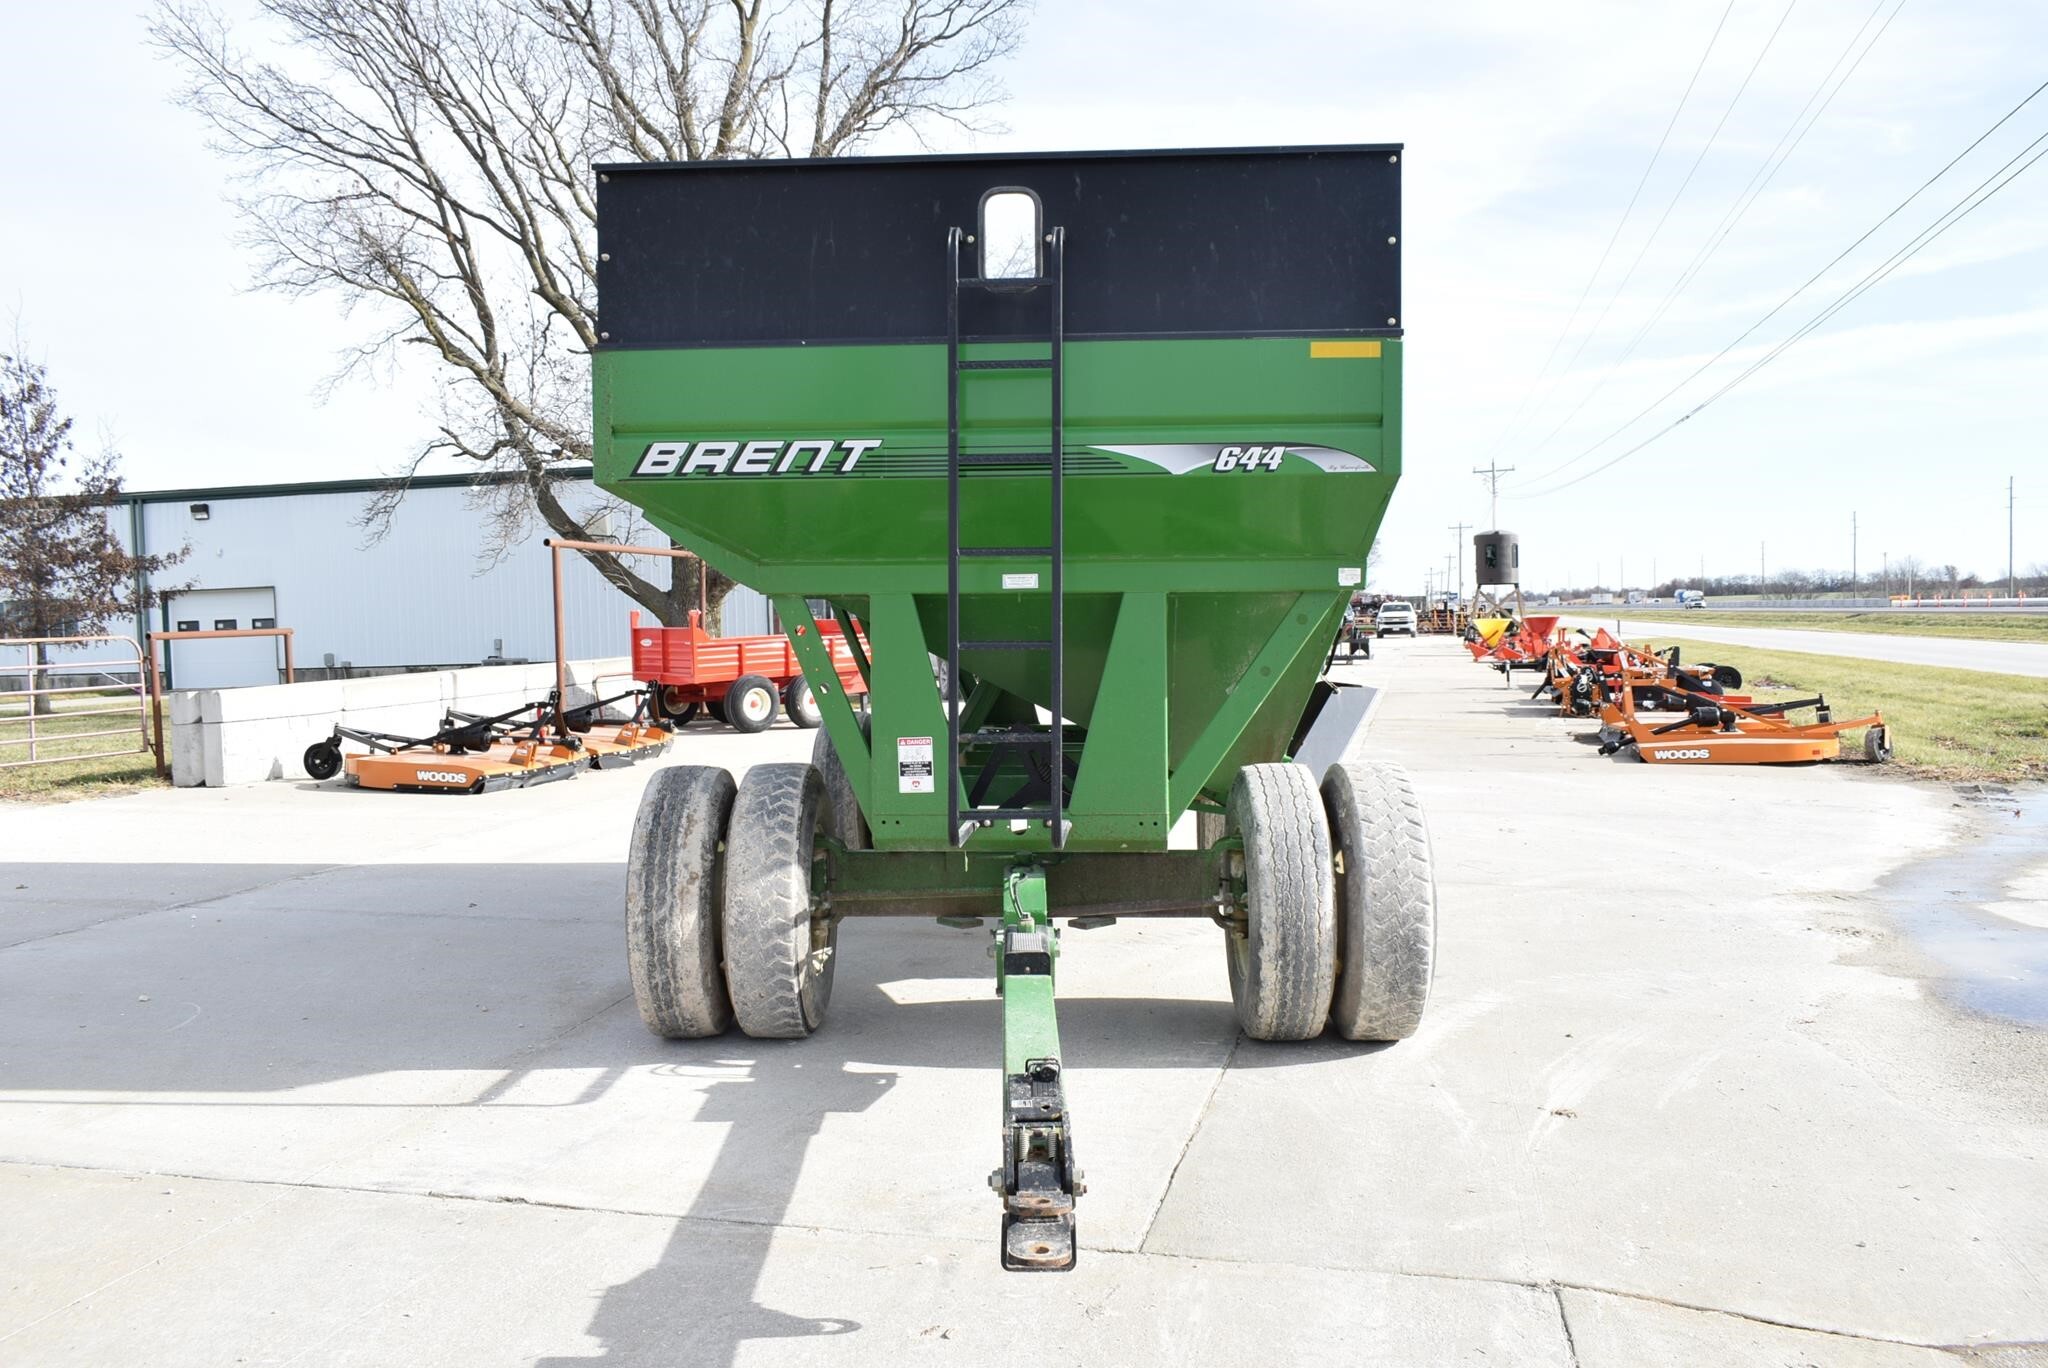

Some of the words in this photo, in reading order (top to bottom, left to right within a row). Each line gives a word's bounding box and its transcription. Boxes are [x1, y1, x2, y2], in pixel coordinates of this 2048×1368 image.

[632, 439, 884, 476] BRENT
[1212, 446, 1286, 473] 644
[1654, 749, 1710, 760] WOODS
[416, 770, 467, 783] WOODS
